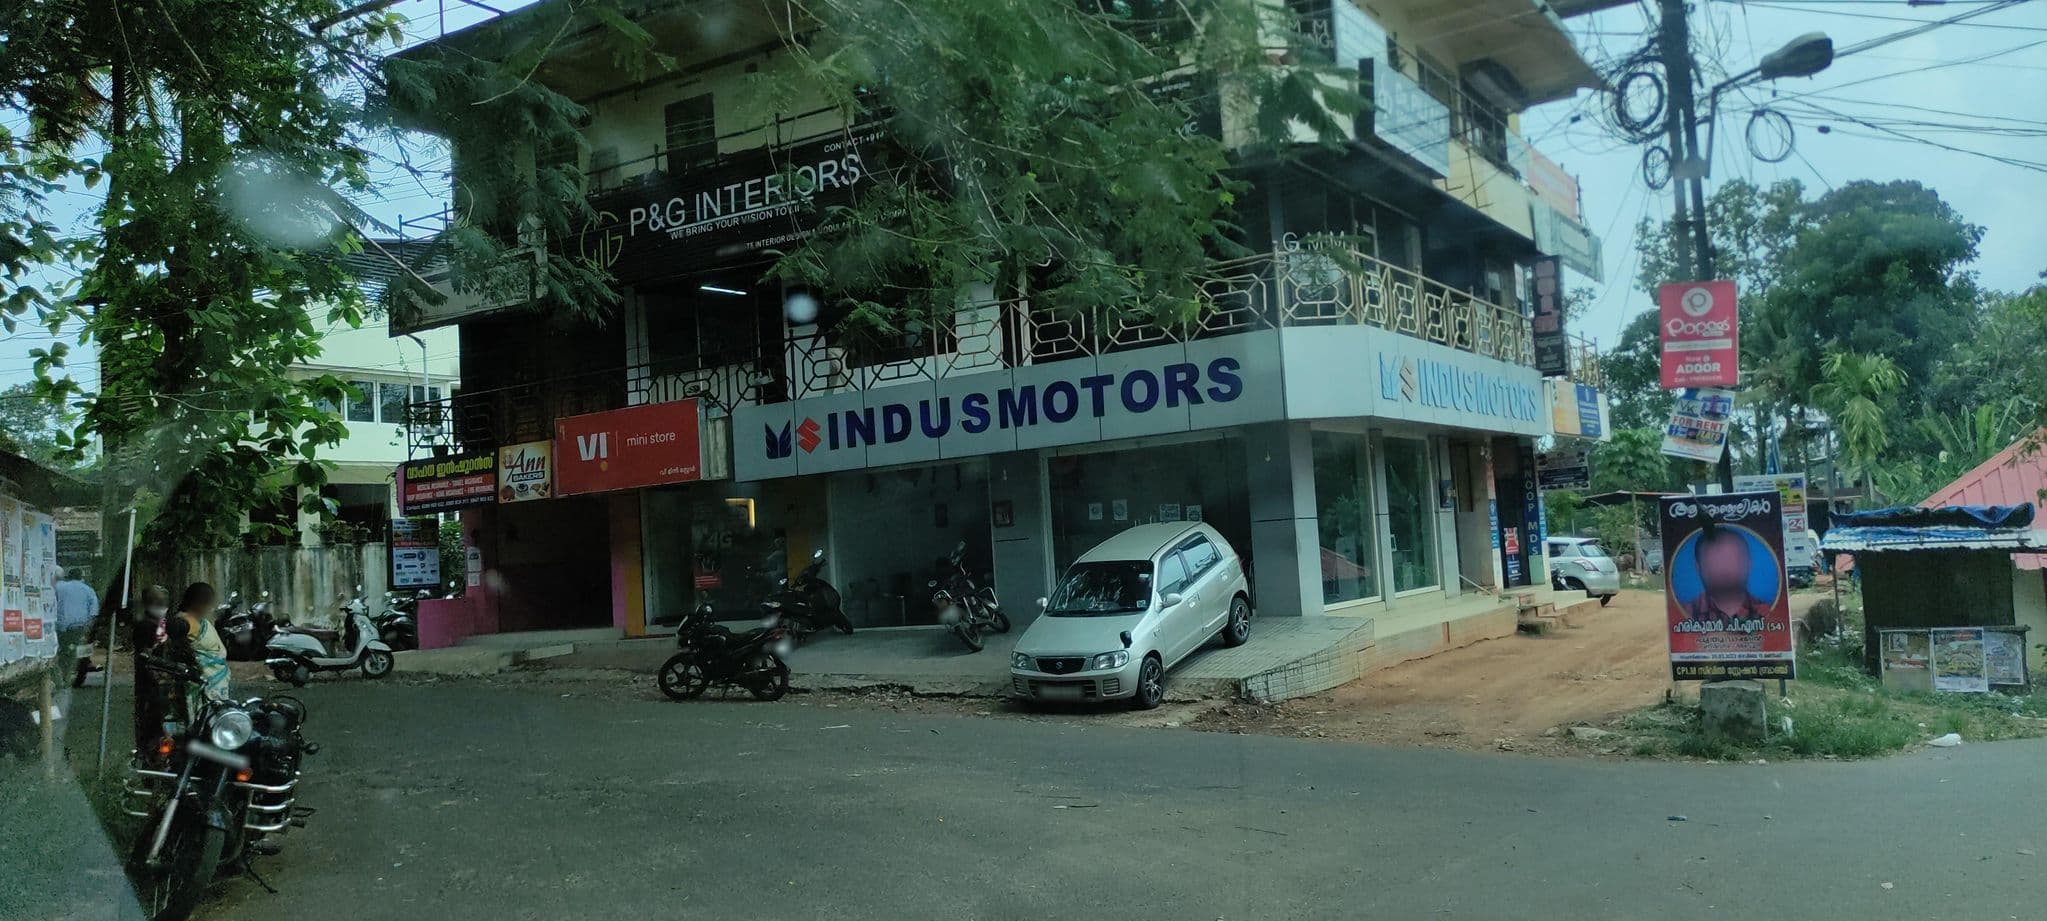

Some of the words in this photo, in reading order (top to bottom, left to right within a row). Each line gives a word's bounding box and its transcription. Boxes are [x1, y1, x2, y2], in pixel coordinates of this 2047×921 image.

[629, 196, 686, 237] P&G
[695, 153, 861, 220] INTERIORS
[670, 229, 685, 240] WE
[685, 223, 713, 236] BRING
[715, 217, 740, 230] YOUR
[740, 210, 773, 224] VISION
[775, 206, 787, 217] TO
[756, 235, 785, 248] INTERIOR
[1676, 362, 1720, 374] ADOOR
[1672, 415, 1693, 427] FOR
[1696, 419, 1725, 431] RENT
[627, 433, 648, 447] mini
[649, 431, 676, 444] store
[406, 464, 435, 479] വാഹന
[504, 447, 546, 482] Ann
[512, 472, 544, 481] BAKERS
[1668, 498, 1771, 521] ആരാഞ്ജലികൾ
